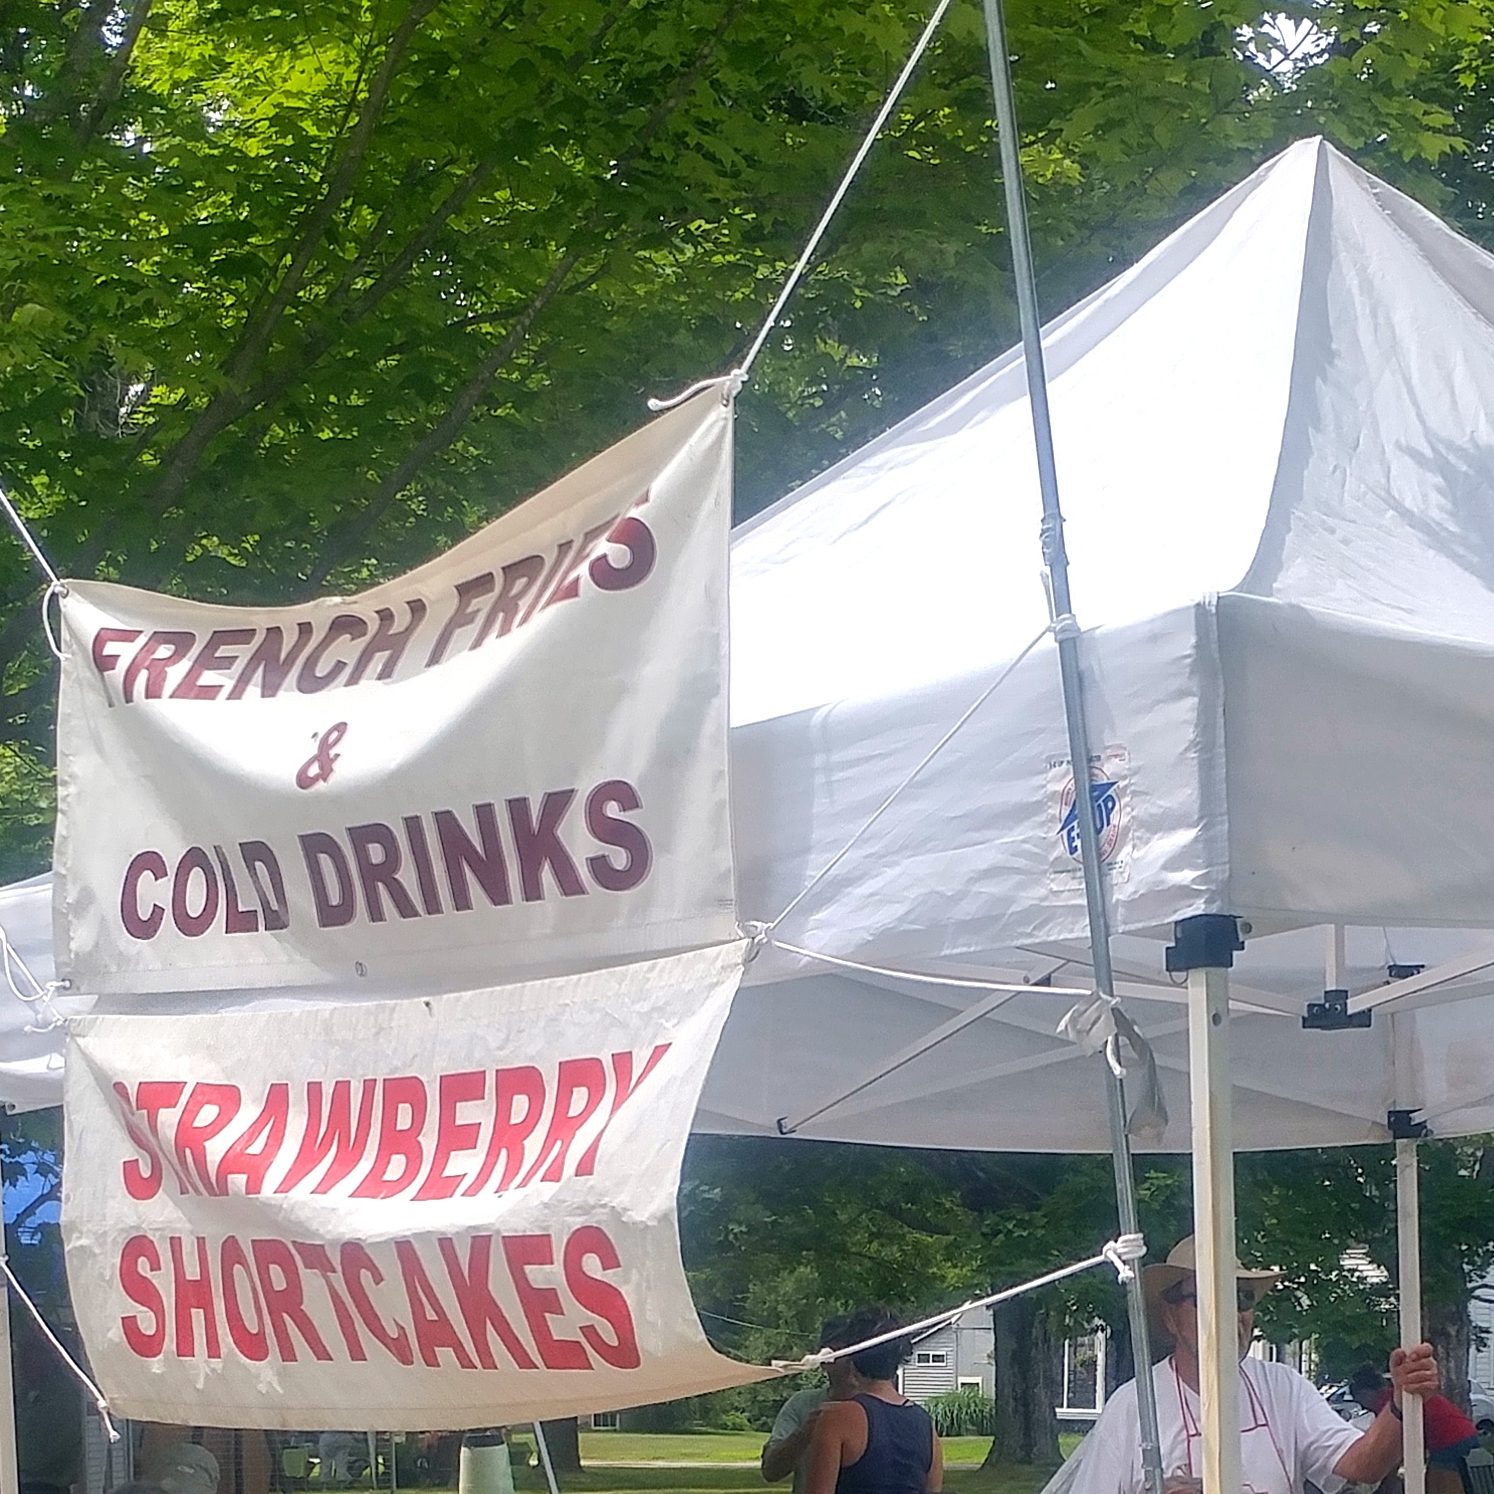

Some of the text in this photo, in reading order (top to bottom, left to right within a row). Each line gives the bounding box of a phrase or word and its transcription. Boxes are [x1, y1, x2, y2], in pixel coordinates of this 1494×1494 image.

[92, 490, 658, 707] FRENCH FRIES
[295, 721, 348, 790] &
[120, 779, 654, 941] COLD DRINKS
[112, 1042, 673, 1202] STRAWBERRY
[120, 1225, 641, 1370] SHORTCAKES
